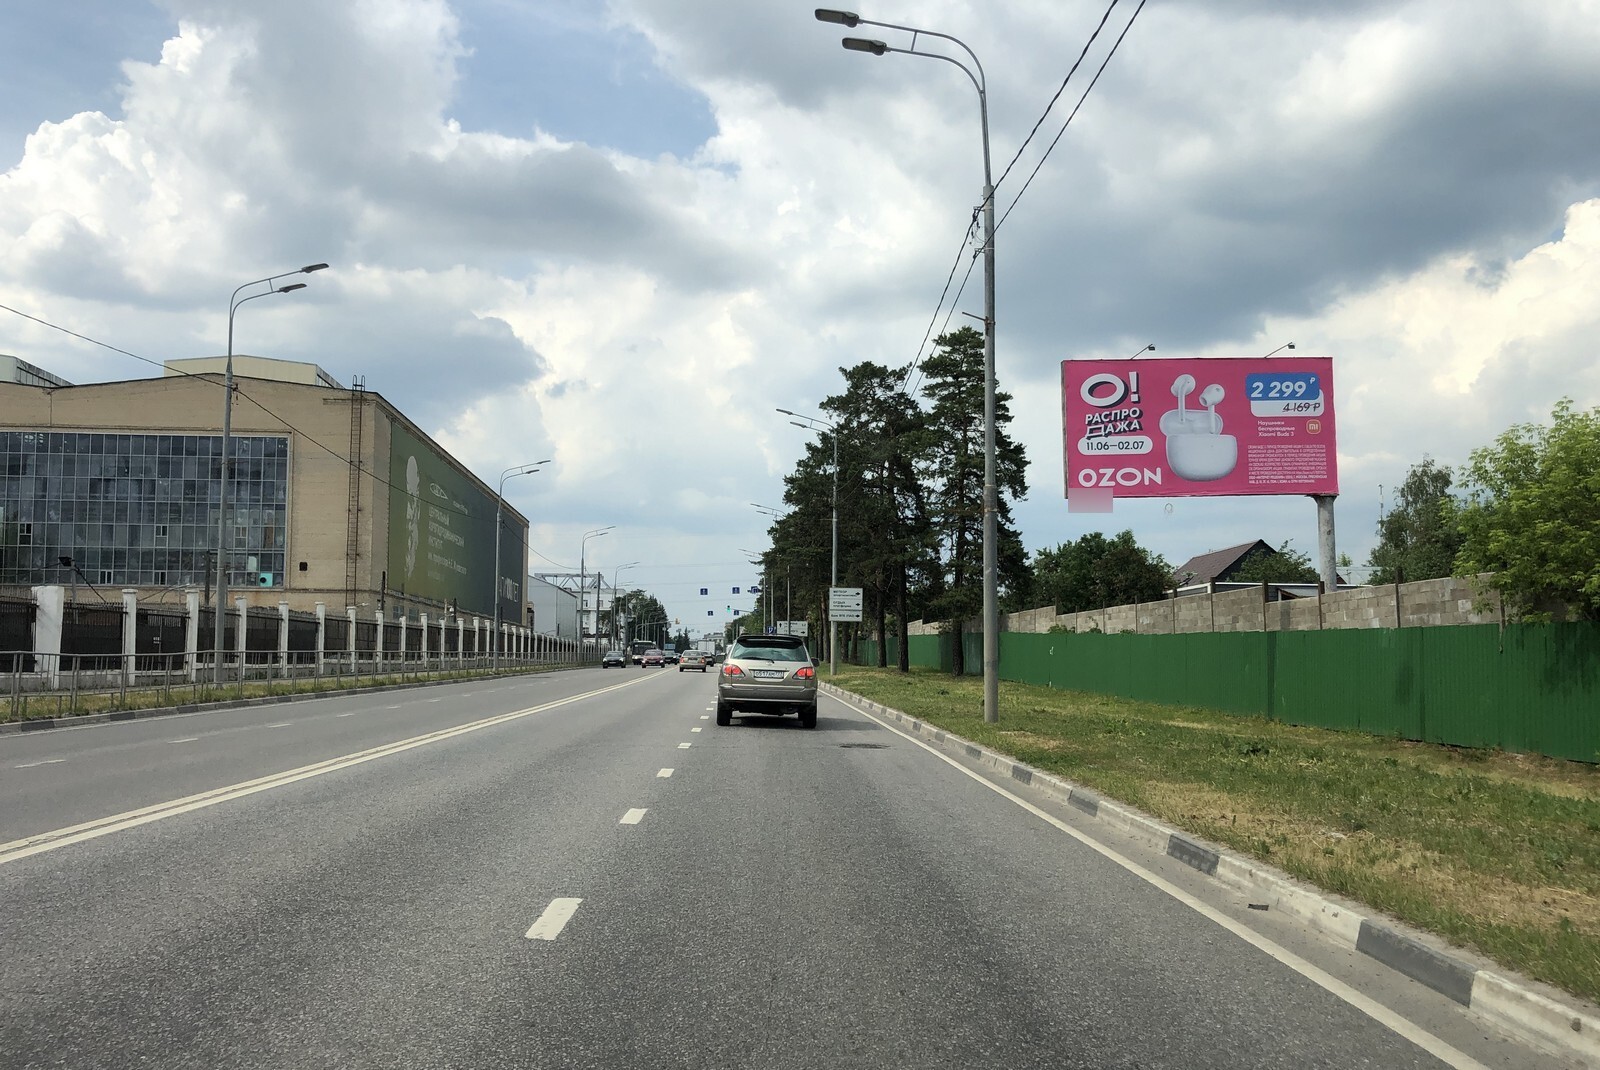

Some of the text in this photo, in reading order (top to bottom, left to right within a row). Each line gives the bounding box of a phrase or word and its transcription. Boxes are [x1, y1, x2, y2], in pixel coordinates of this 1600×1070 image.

[1085, 407, 1141, 425] РАСПРО
[1085, 419, 1141, 439] ДАЖА
[1078, 467, 1162, 487] OZON
